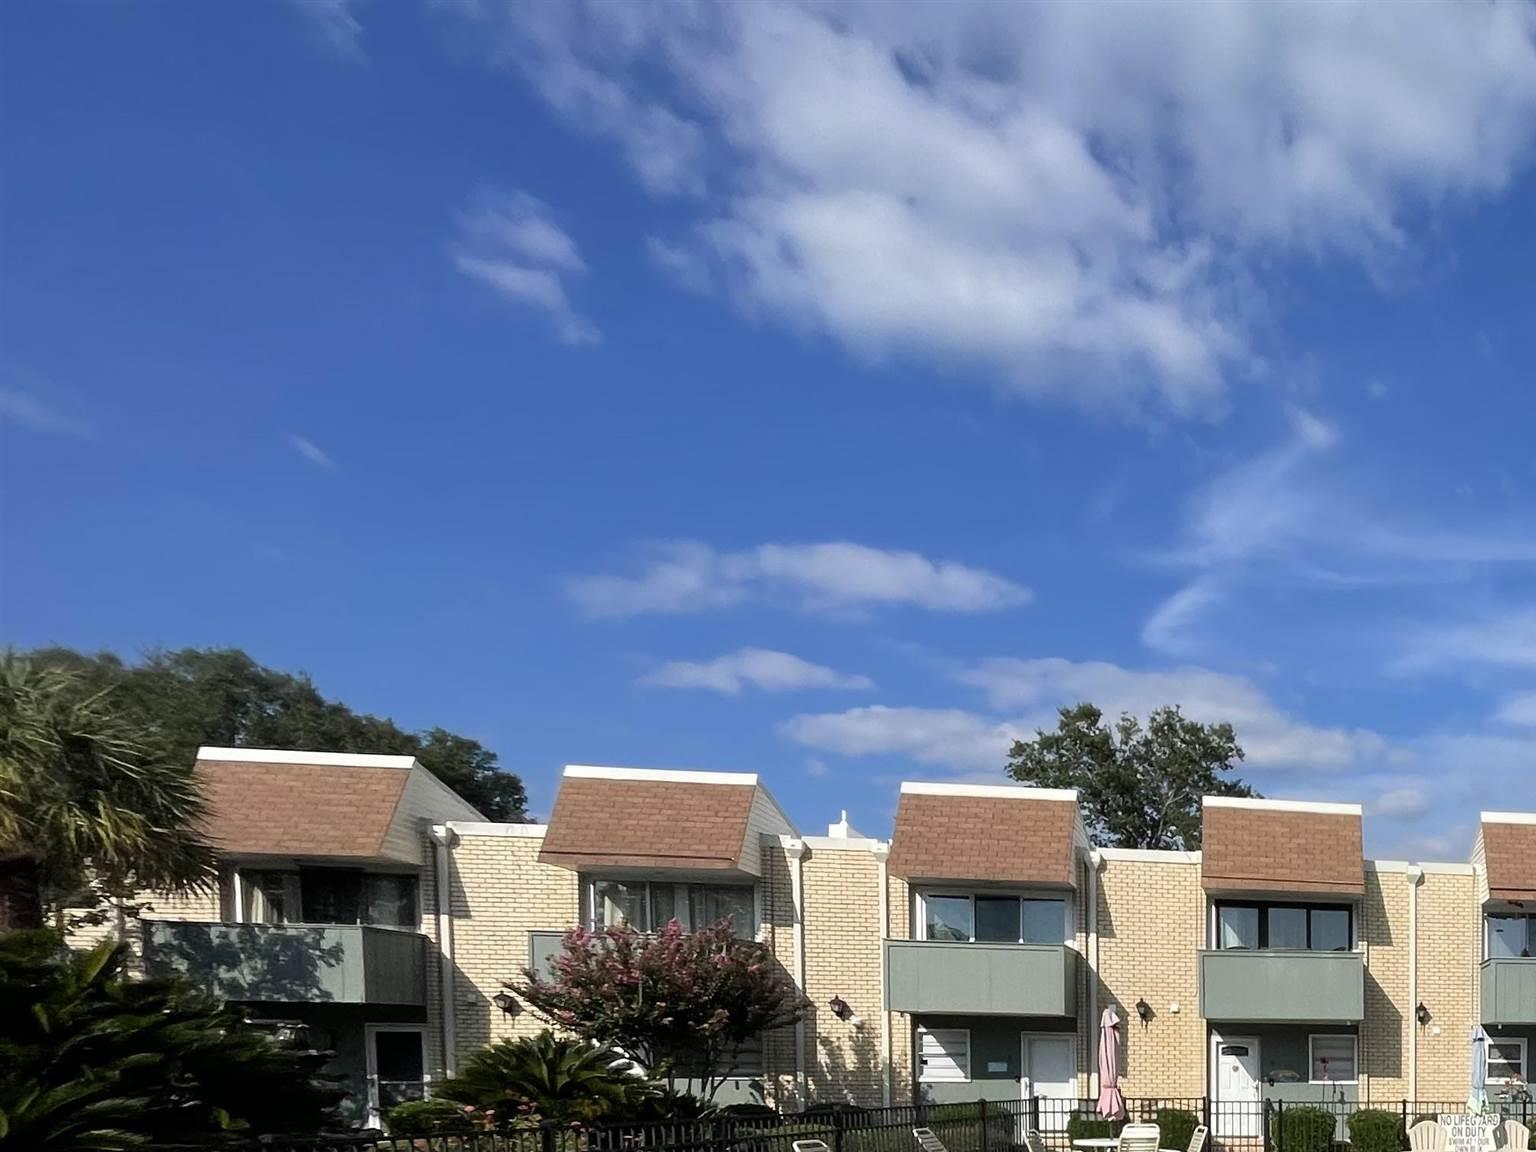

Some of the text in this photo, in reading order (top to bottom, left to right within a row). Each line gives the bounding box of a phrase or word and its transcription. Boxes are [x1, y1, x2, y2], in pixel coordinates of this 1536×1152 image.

[1440, 1115, 1452, 1126] NO
[1452, 1127, 1486, 1137] ON DUTY
